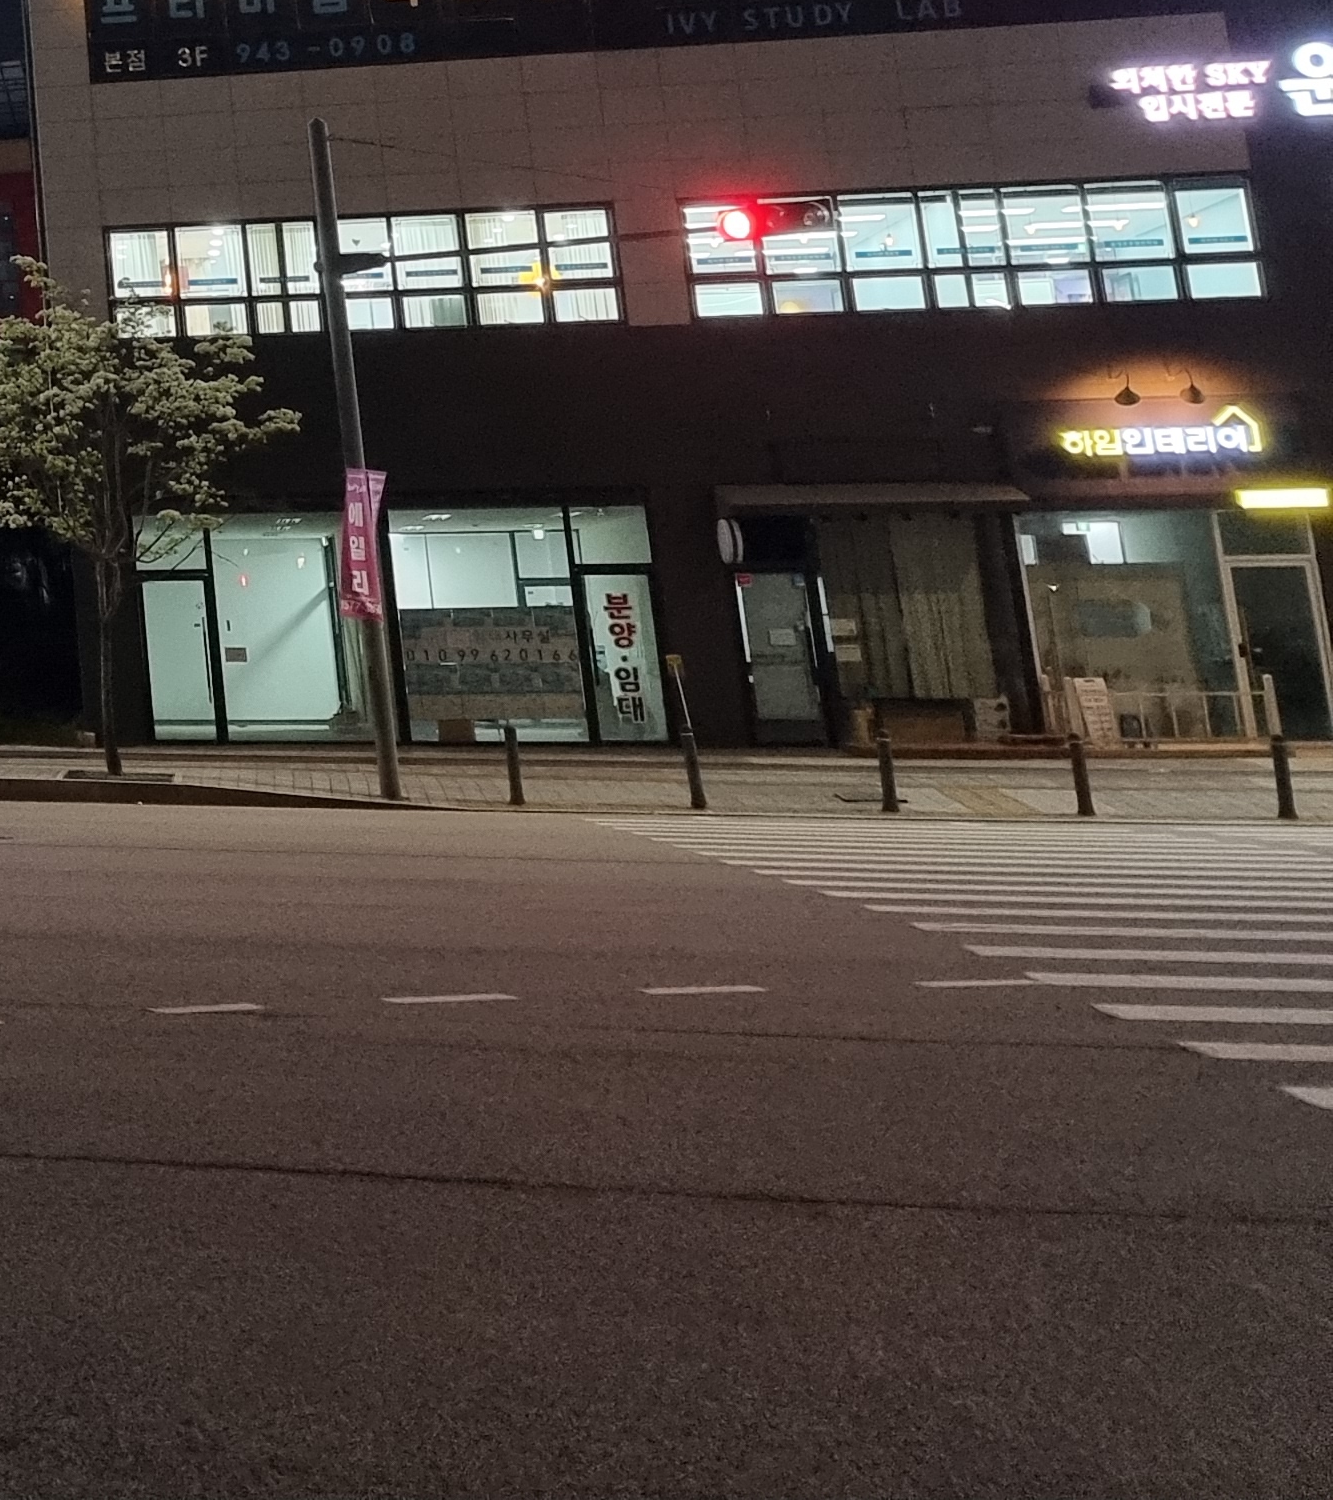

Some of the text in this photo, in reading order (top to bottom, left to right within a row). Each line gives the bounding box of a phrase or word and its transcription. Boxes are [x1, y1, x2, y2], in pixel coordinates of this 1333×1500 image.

[667, 10, 719, 34] IVY
[743, 2, 853, 31] STUDY
[104, 47, 145, 73] 본점
[178, 46, 210, 67] 3F
[1204, 60, 1272, 87] SKY
[1138, 89, 1255, 123] 입시전문
[504, 629, 550, 644] 사무실
